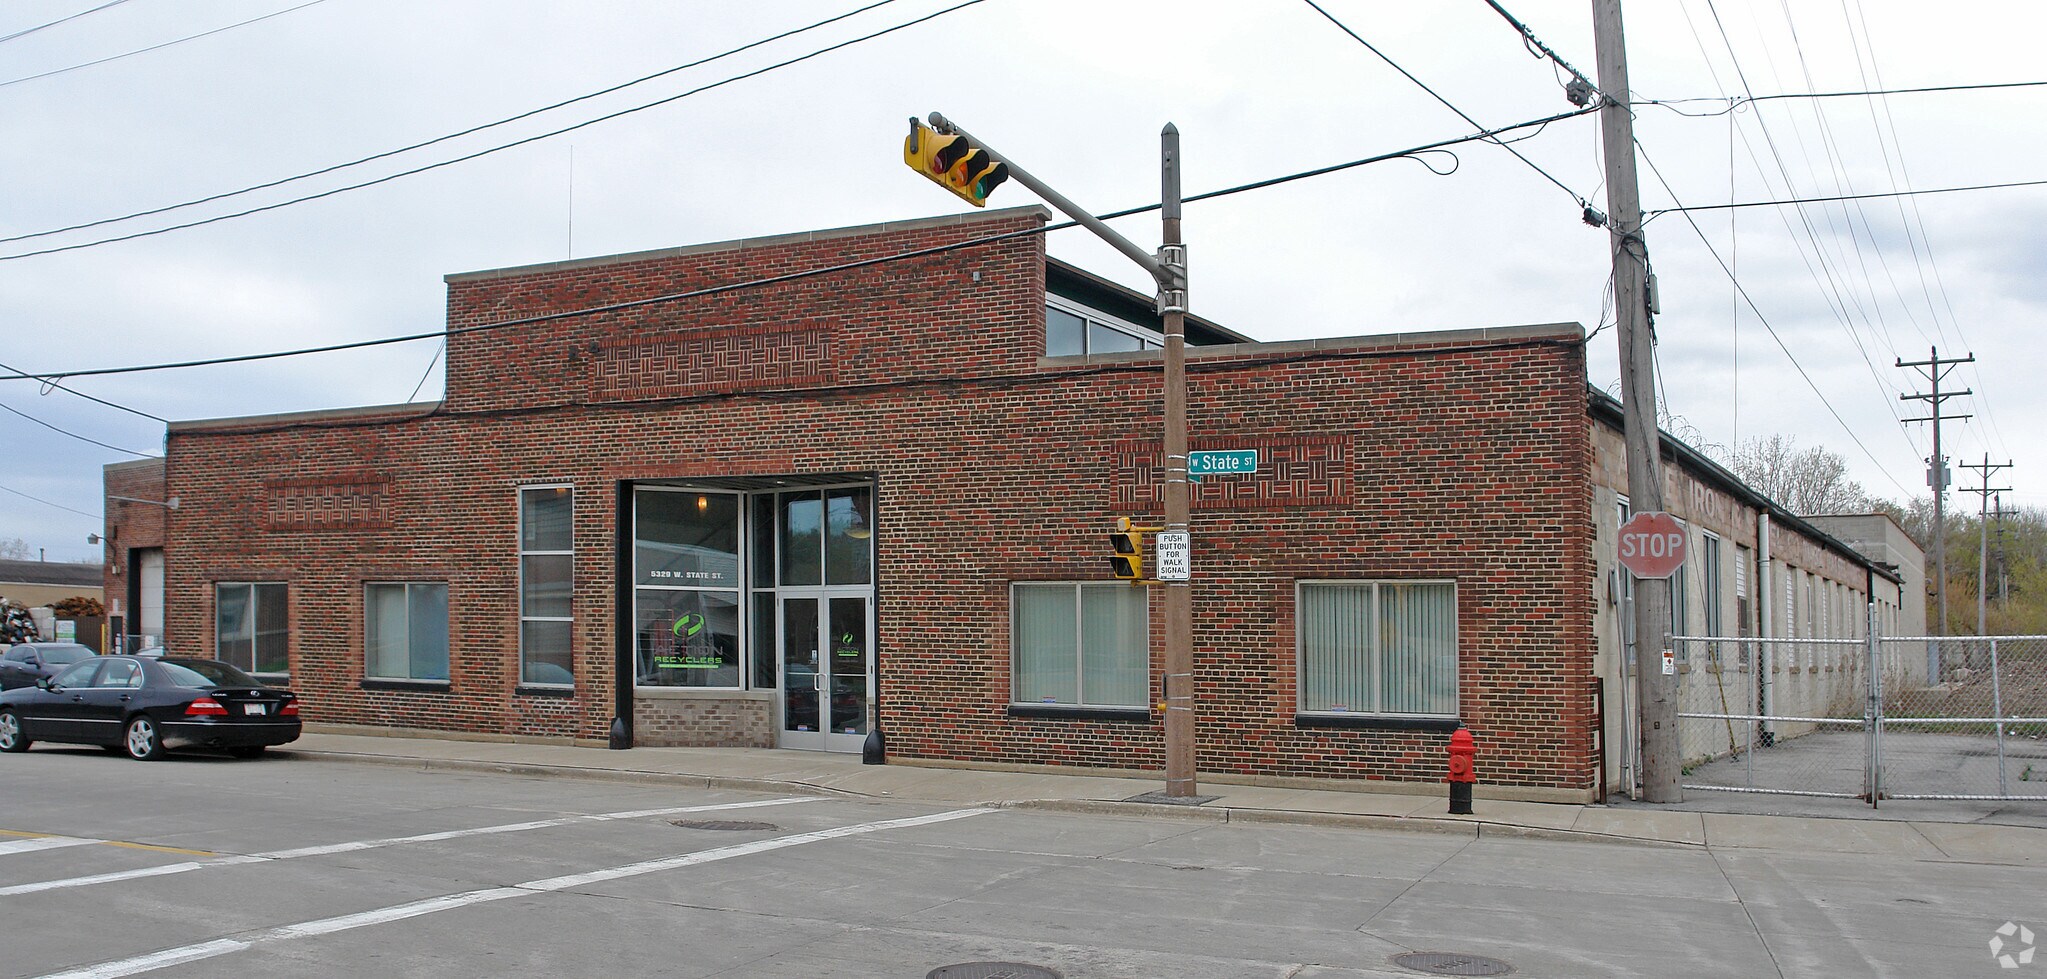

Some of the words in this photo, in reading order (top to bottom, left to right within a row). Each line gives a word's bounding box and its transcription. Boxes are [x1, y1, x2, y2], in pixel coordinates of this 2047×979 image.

[1192, 458, 1199, 467] W
[1202, 454, 1239, 470] State
[1244, 457, 1253, 466] ST
[1163, 535, 1183, 543] PUSH
[1621, 532, 1683, 558] STOP
[650, 570, 671, 578] 5329
[673, 571, 684, 579] W.
[686, 571, 709, 579] STATE
[711, 572, 724, 580] ST.
[654, 656, 722, 664] RECYCLERS
